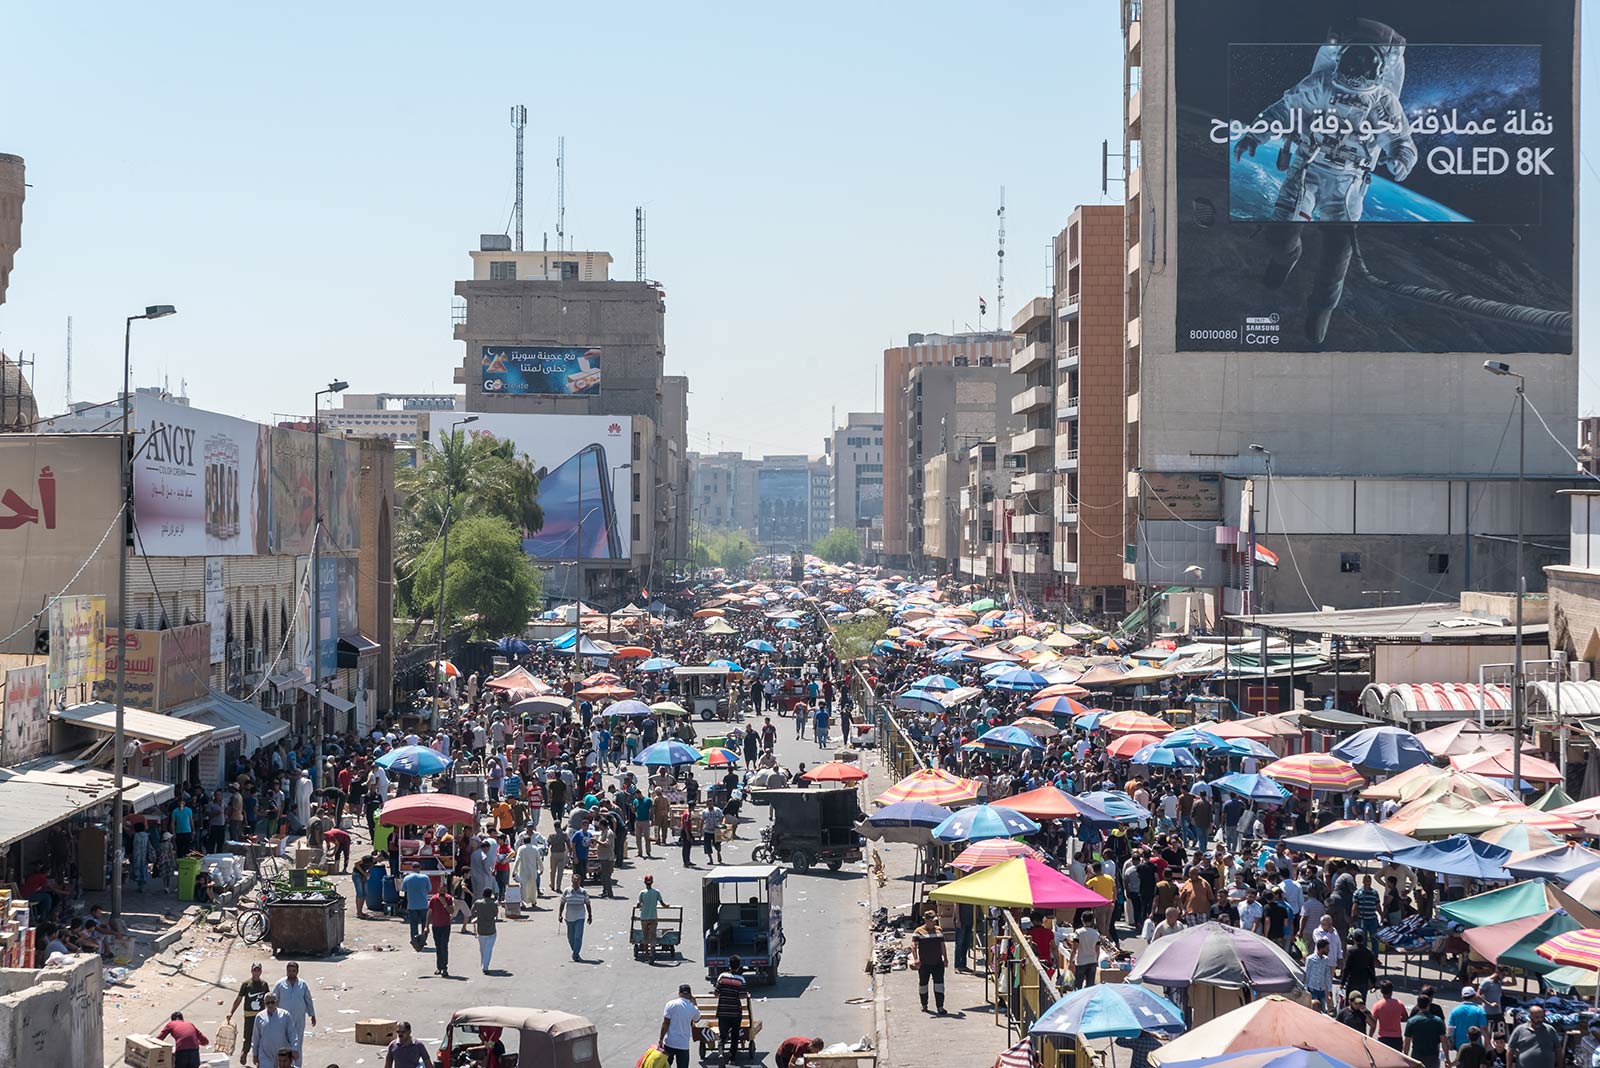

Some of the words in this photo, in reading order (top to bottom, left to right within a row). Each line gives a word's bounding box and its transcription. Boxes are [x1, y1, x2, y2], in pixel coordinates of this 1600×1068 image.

[1209, 107, 1303, 144] الوضوح
[1310, 108, 1353, 134] دقة
[1409, 108, 1497, 135] عملاقة
[1503, 108, 1553, 135] نقلة
[1426, 146, 1509, 176] QLED
[1515, 146, 1555, 176] 8K
[1189, 329, 1238, 340] 80010080
[1245, 333, 1280, 345] Care
[537, 351, 561, 361] عجينة
[563, 352, 576, 361] مع
[520, 363, 542, 373] لمتنا
